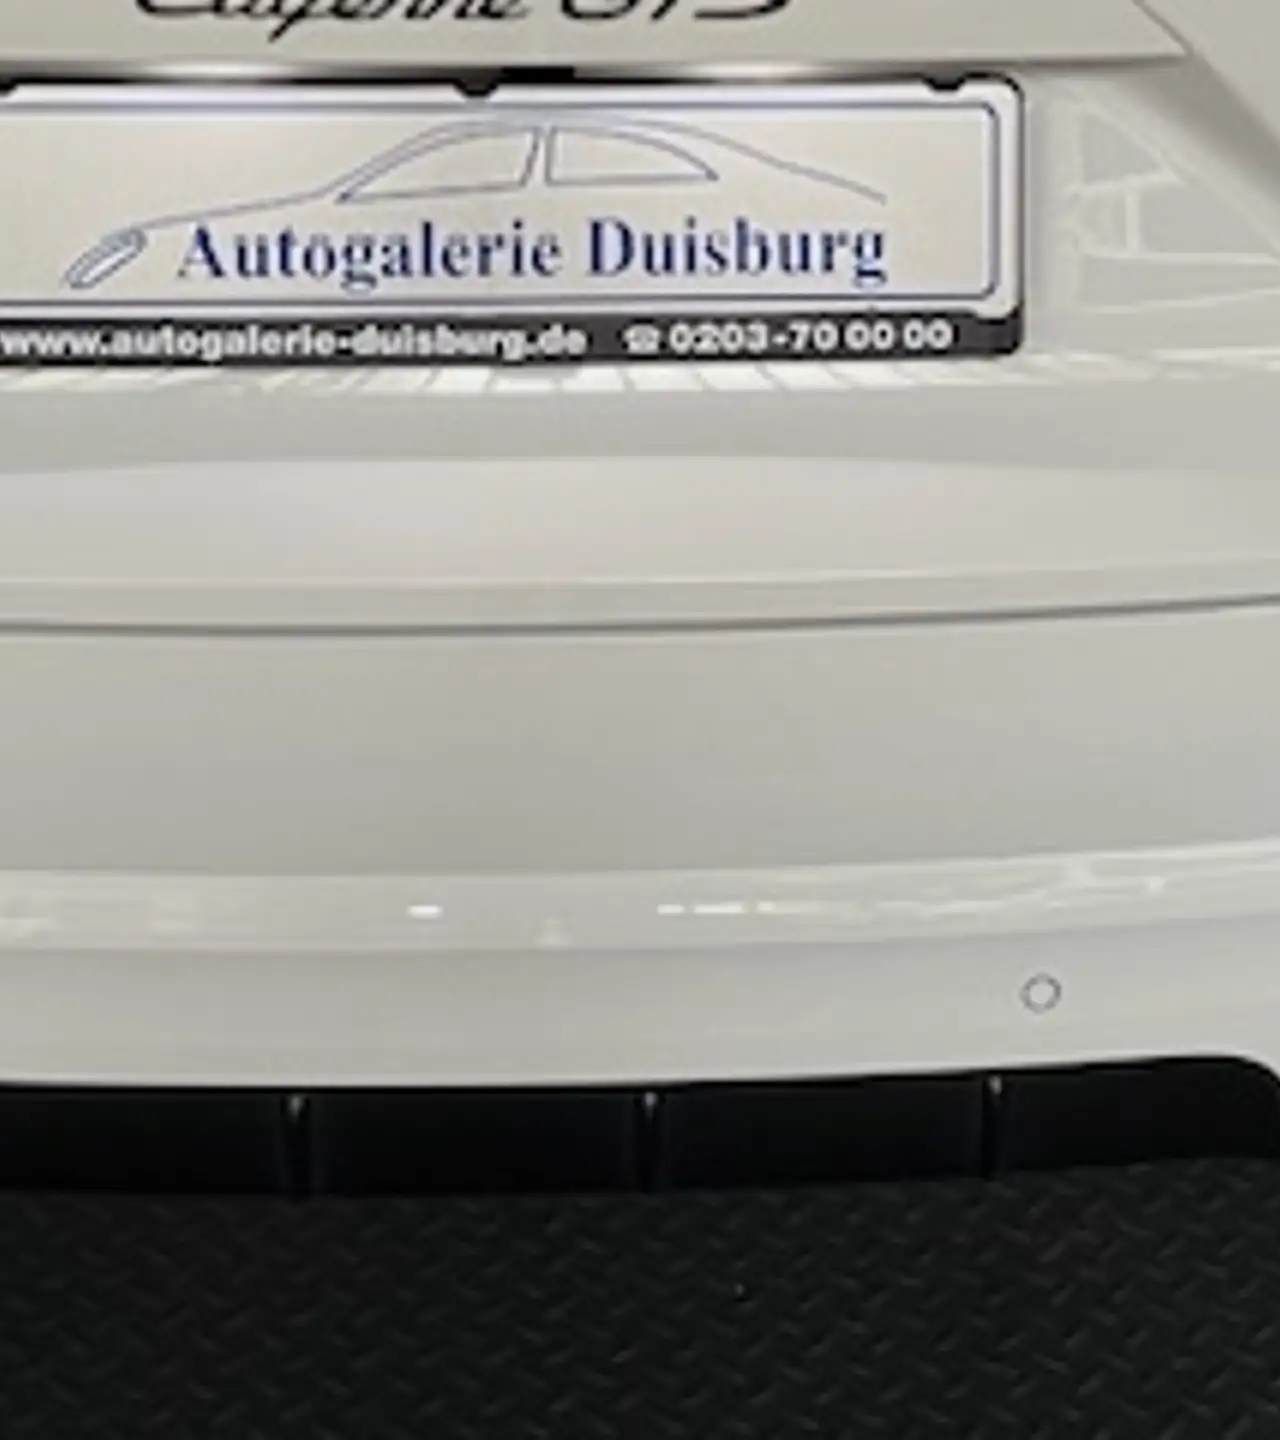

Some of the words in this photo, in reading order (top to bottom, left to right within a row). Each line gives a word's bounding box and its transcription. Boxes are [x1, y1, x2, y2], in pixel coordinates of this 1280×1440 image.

[176, 216, 562, 292] Autogalerie
[584, 216, 890, 286] Duisburg
[667, 321, 839, 355] 0203-70
[844, 321, 895, 353] 00
[902, 320, 954, 351] 00
